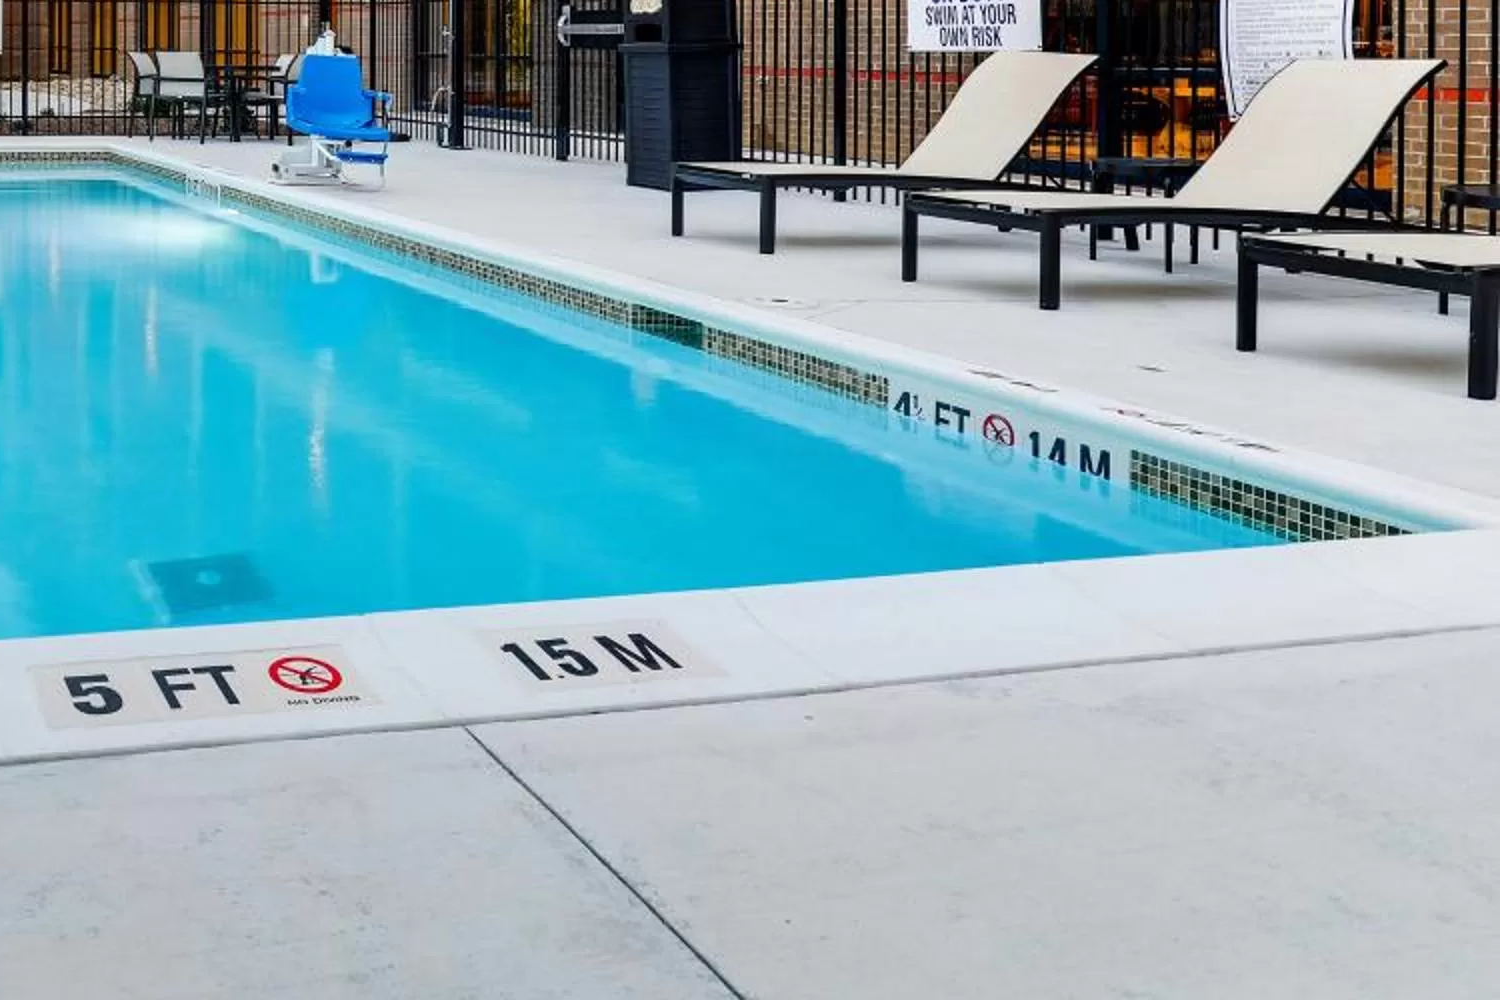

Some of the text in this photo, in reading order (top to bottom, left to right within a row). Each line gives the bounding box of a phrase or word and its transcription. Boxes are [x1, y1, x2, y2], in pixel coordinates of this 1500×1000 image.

[925, 3, 1017, 26] SWIM AT YOUR
[940, 25, 1003, 47] OWN RISK
[935, 401, 971, 433] FT
[1080, 444, 1111, 480] M
[592, 633, 684, 673] M
[63, 664, 241, 716] 5 FT
